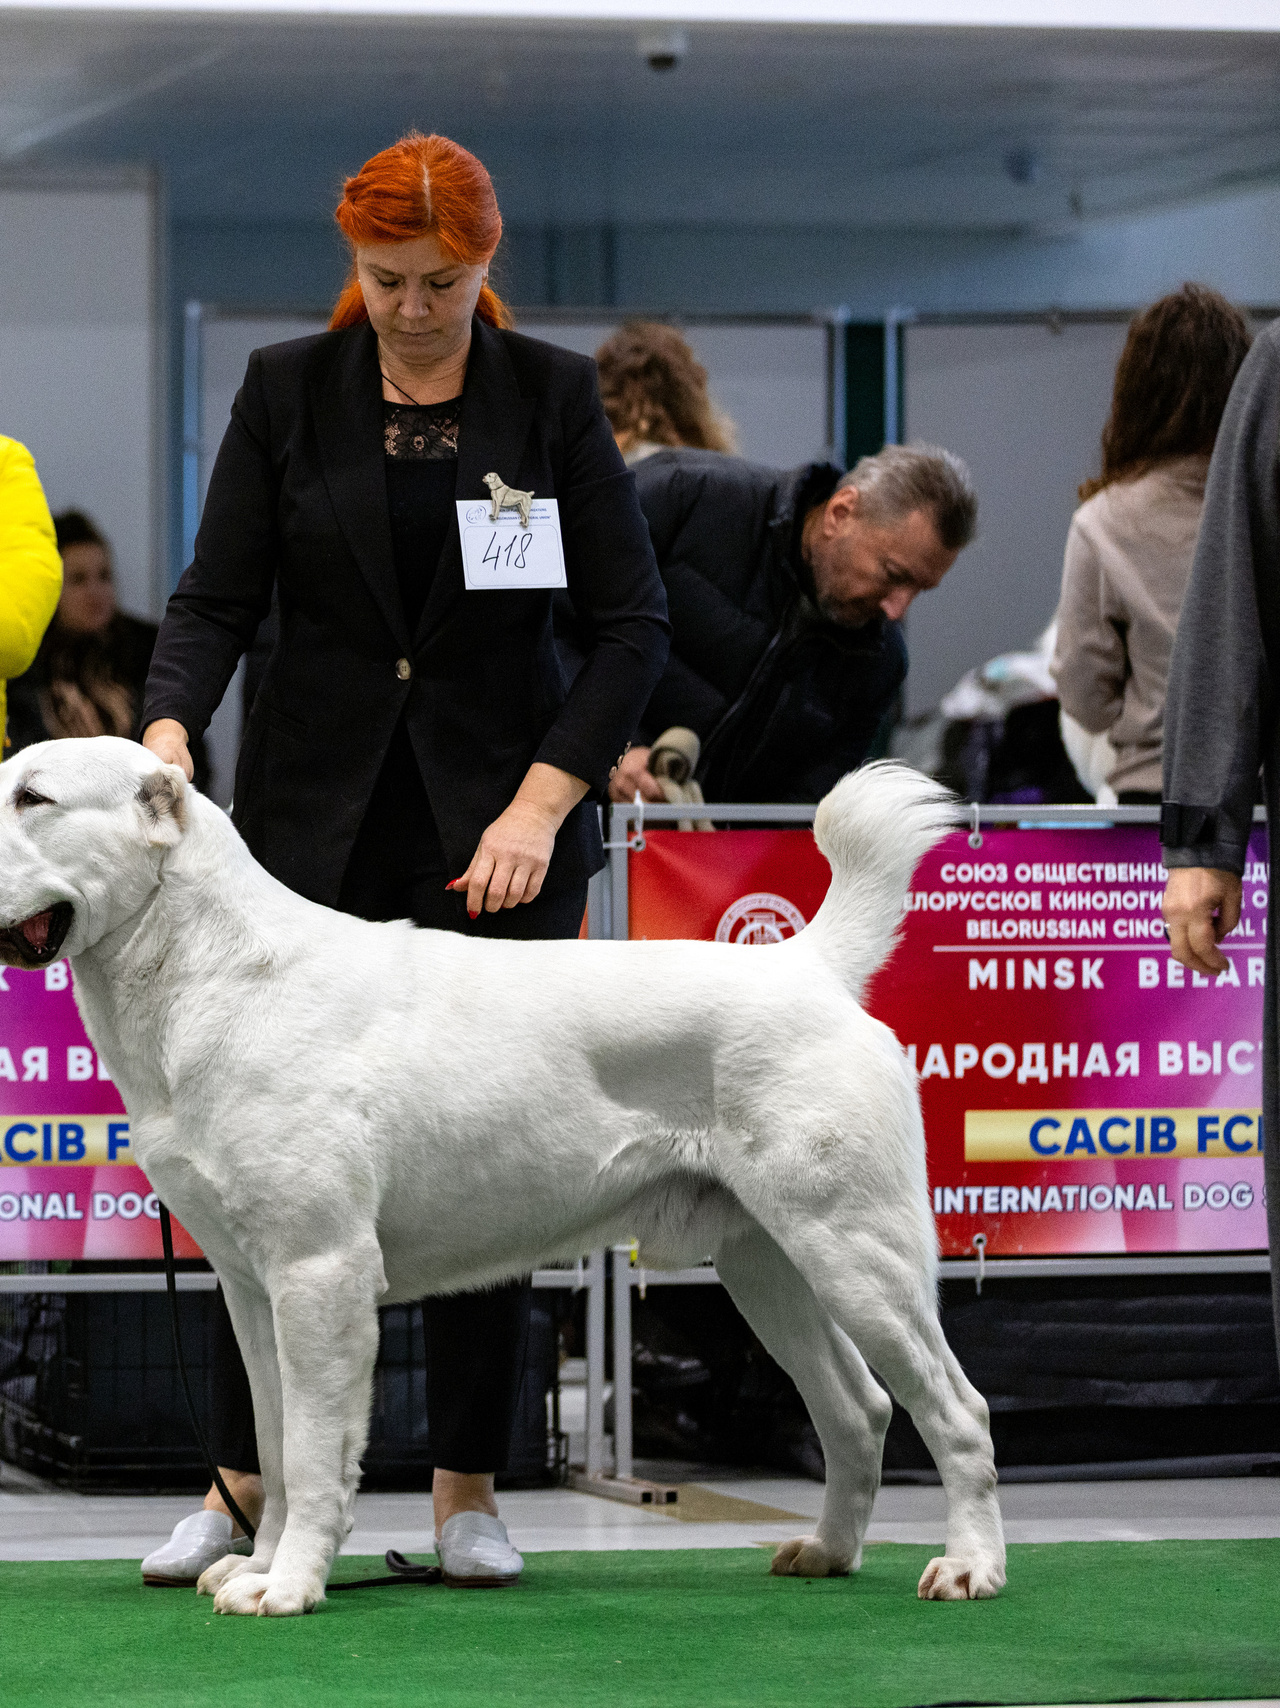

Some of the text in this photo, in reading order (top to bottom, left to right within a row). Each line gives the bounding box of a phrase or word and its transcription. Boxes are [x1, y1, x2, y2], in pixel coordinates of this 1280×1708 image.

[482, 531, 533, 571] 418
[940, 862, 1008, 883] СОЮЗ
[966, 918, 1106, 940] BELORUSSIAN
[968, 957, 1105, 990] MINSK
[1158, 1040, 1263, 1077] ВЫС
[1029, 1116, 1177, 1156] CACIB
[933, 1183, 1174, 1214] INTERNATIONAL
[1182, 1181, 1255, 1212] DOG
